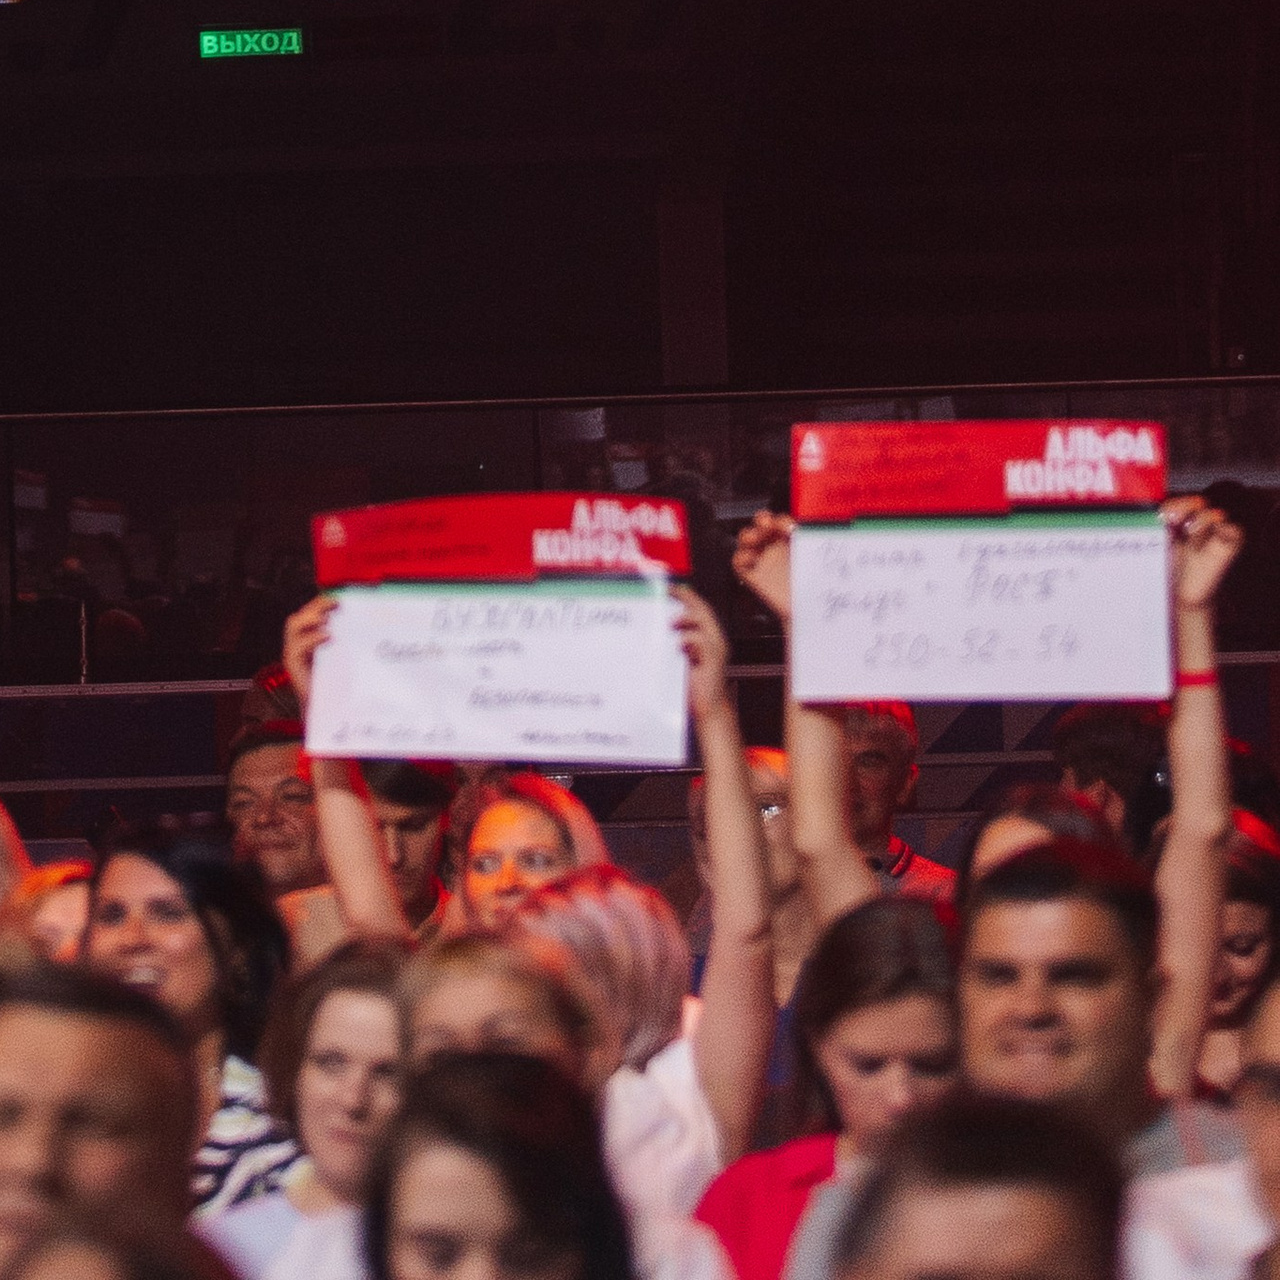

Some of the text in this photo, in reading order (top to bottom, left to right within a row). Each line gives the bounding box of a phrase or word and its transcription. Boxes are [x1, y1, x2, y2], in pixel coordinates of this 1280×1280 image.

[202, 32, 300, 54] ВЫХОД
[1045, 425, 1158, 465] АЛЬФА
[1004, 459, 1115, 499] КОНФА
[571, 498, 681, 540] АЛЬФА
[532, 529, 644, 567] КОНФА
